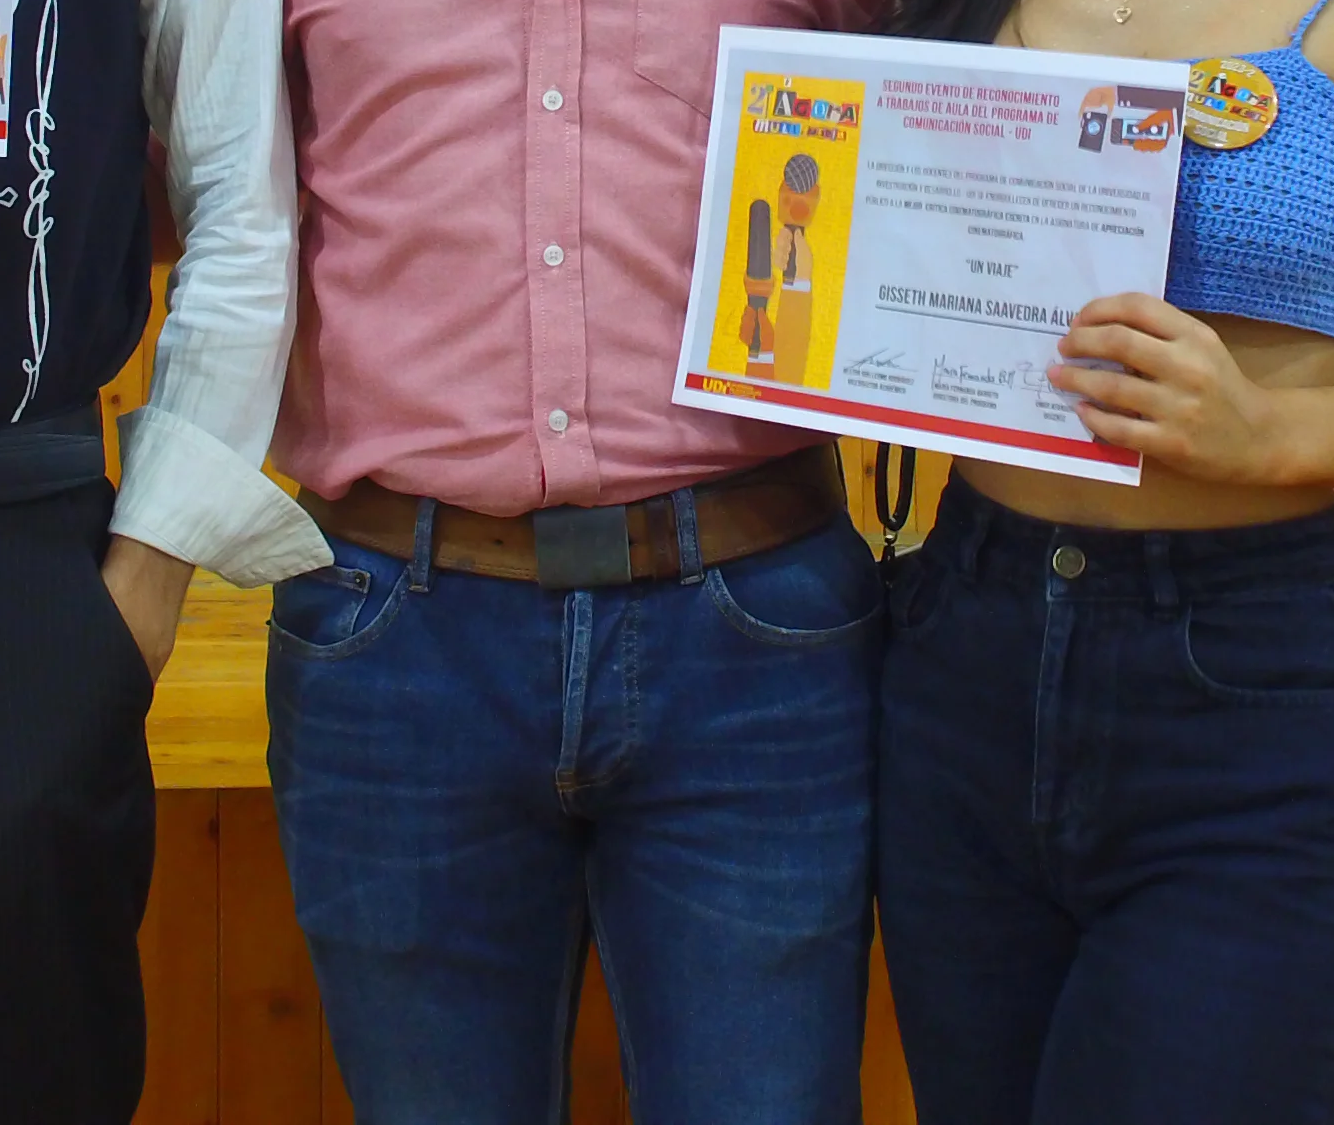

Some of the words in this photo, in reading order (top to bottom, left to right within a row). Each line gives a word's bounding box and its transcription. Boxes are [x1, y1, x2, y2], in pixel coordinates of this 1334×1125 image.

[883, 79, 923, 94] SEGUNDO
[925, 83, 960, 98] EVENTO
[962, 86, 975, 99] DE
[977, 87, 1059, 107] RECONOCIMIENTO
[877, 96, 883, 107] A
[886, 97, 929, 113] TRABAJOS
[931, 101, 944, 114] DE
[945, 102, 969, 117] AULA
[972, 105, 988, 118] DEL
[991, 107, 1044, 123] PROGRAMA
[1047, 113, 1059, 125] DE
[973, 123, 1005, 138] SOCIAL
[1015, 127, 1031, 140] UDI
[878, 284, 926, 304] GISSETH
[929, 292, 982, 315] MARIANA
[985, 300, 1047, 323] SAAVEDRA
